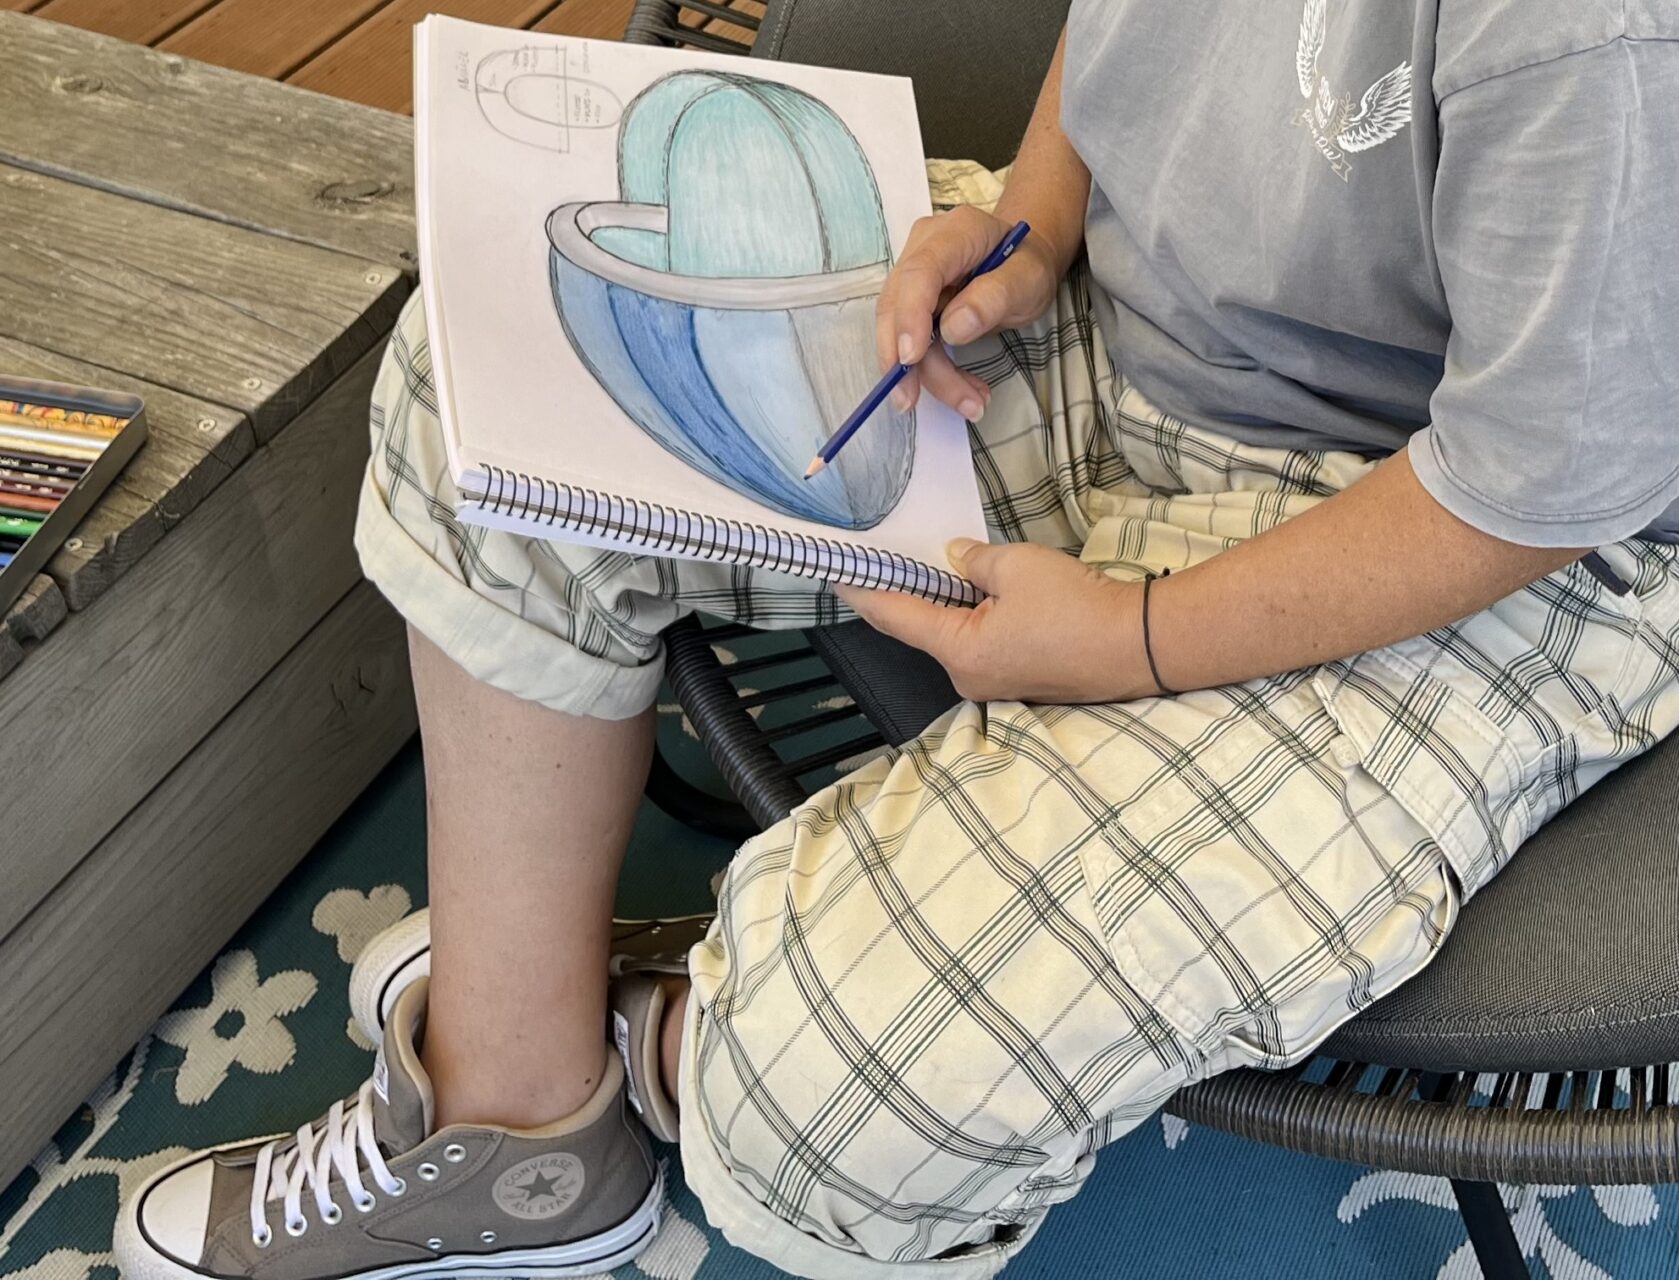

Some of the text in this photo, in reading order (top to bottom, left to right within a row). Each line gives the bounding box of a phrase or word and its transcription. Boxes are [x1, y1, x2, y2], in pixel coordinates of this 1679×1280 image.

[504, 1159, 573, 1187] CONVERSE
[512, 1201, 532, 1213] ALL
[539, 1193, 572, 1213] STAR
